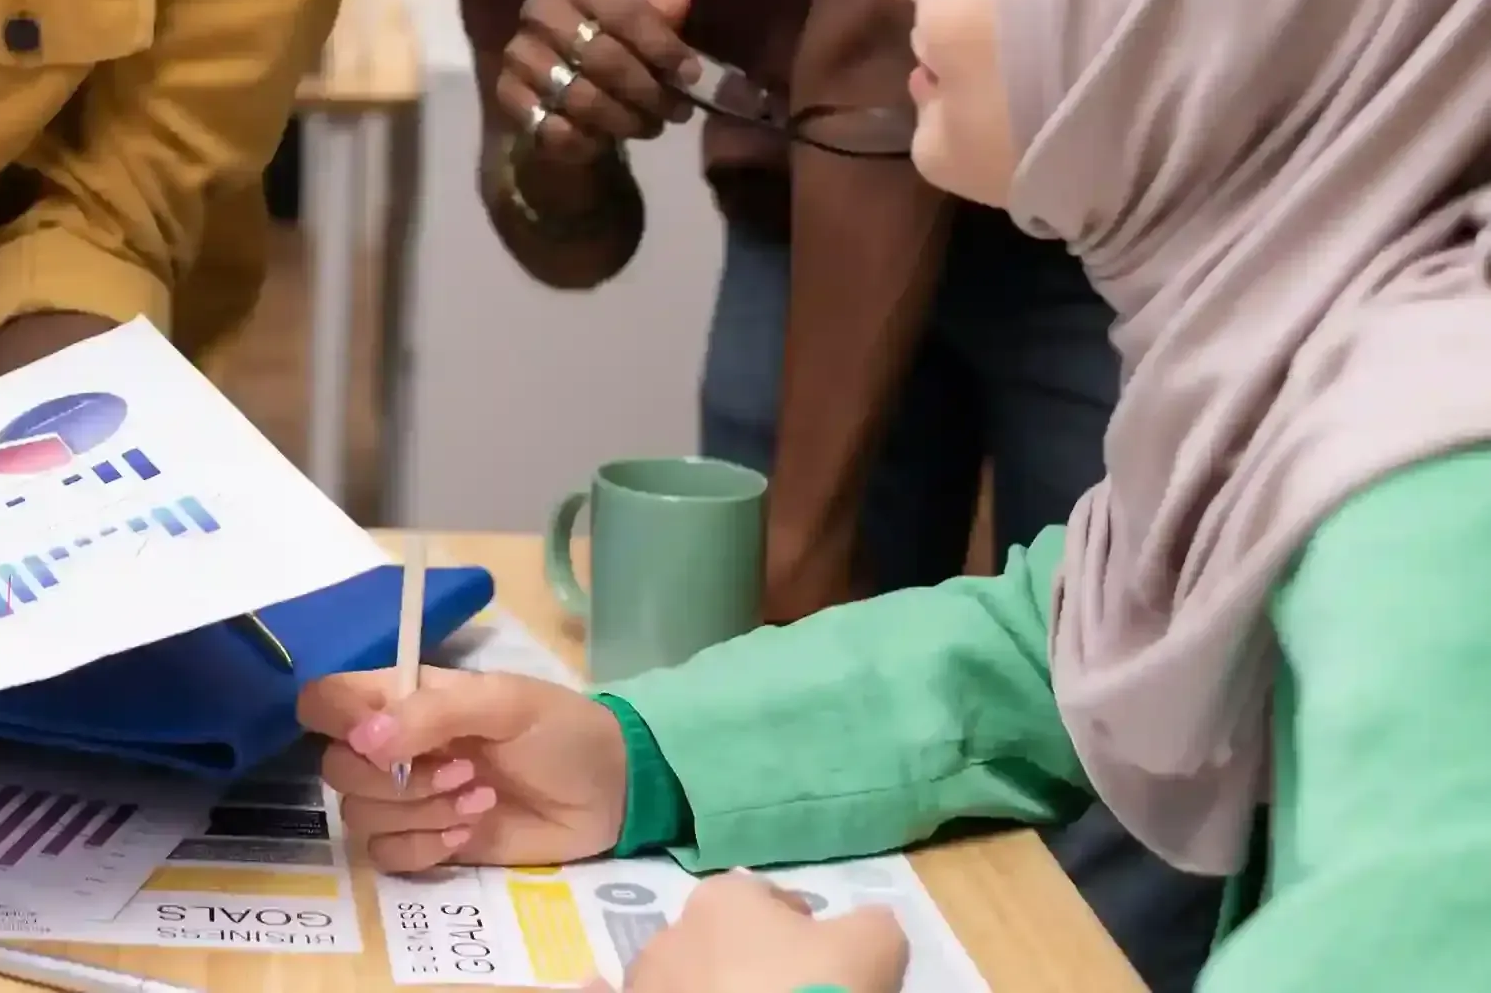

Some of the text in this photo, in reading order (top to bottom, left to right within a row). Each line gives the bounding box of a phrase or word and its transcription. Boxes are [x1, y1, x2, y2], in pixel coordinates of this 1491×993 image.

[156, 904, 333, 928] GOALS
[397, 902, 439, 973] BSNESS
[440, 904, 495, 974] GOALS
